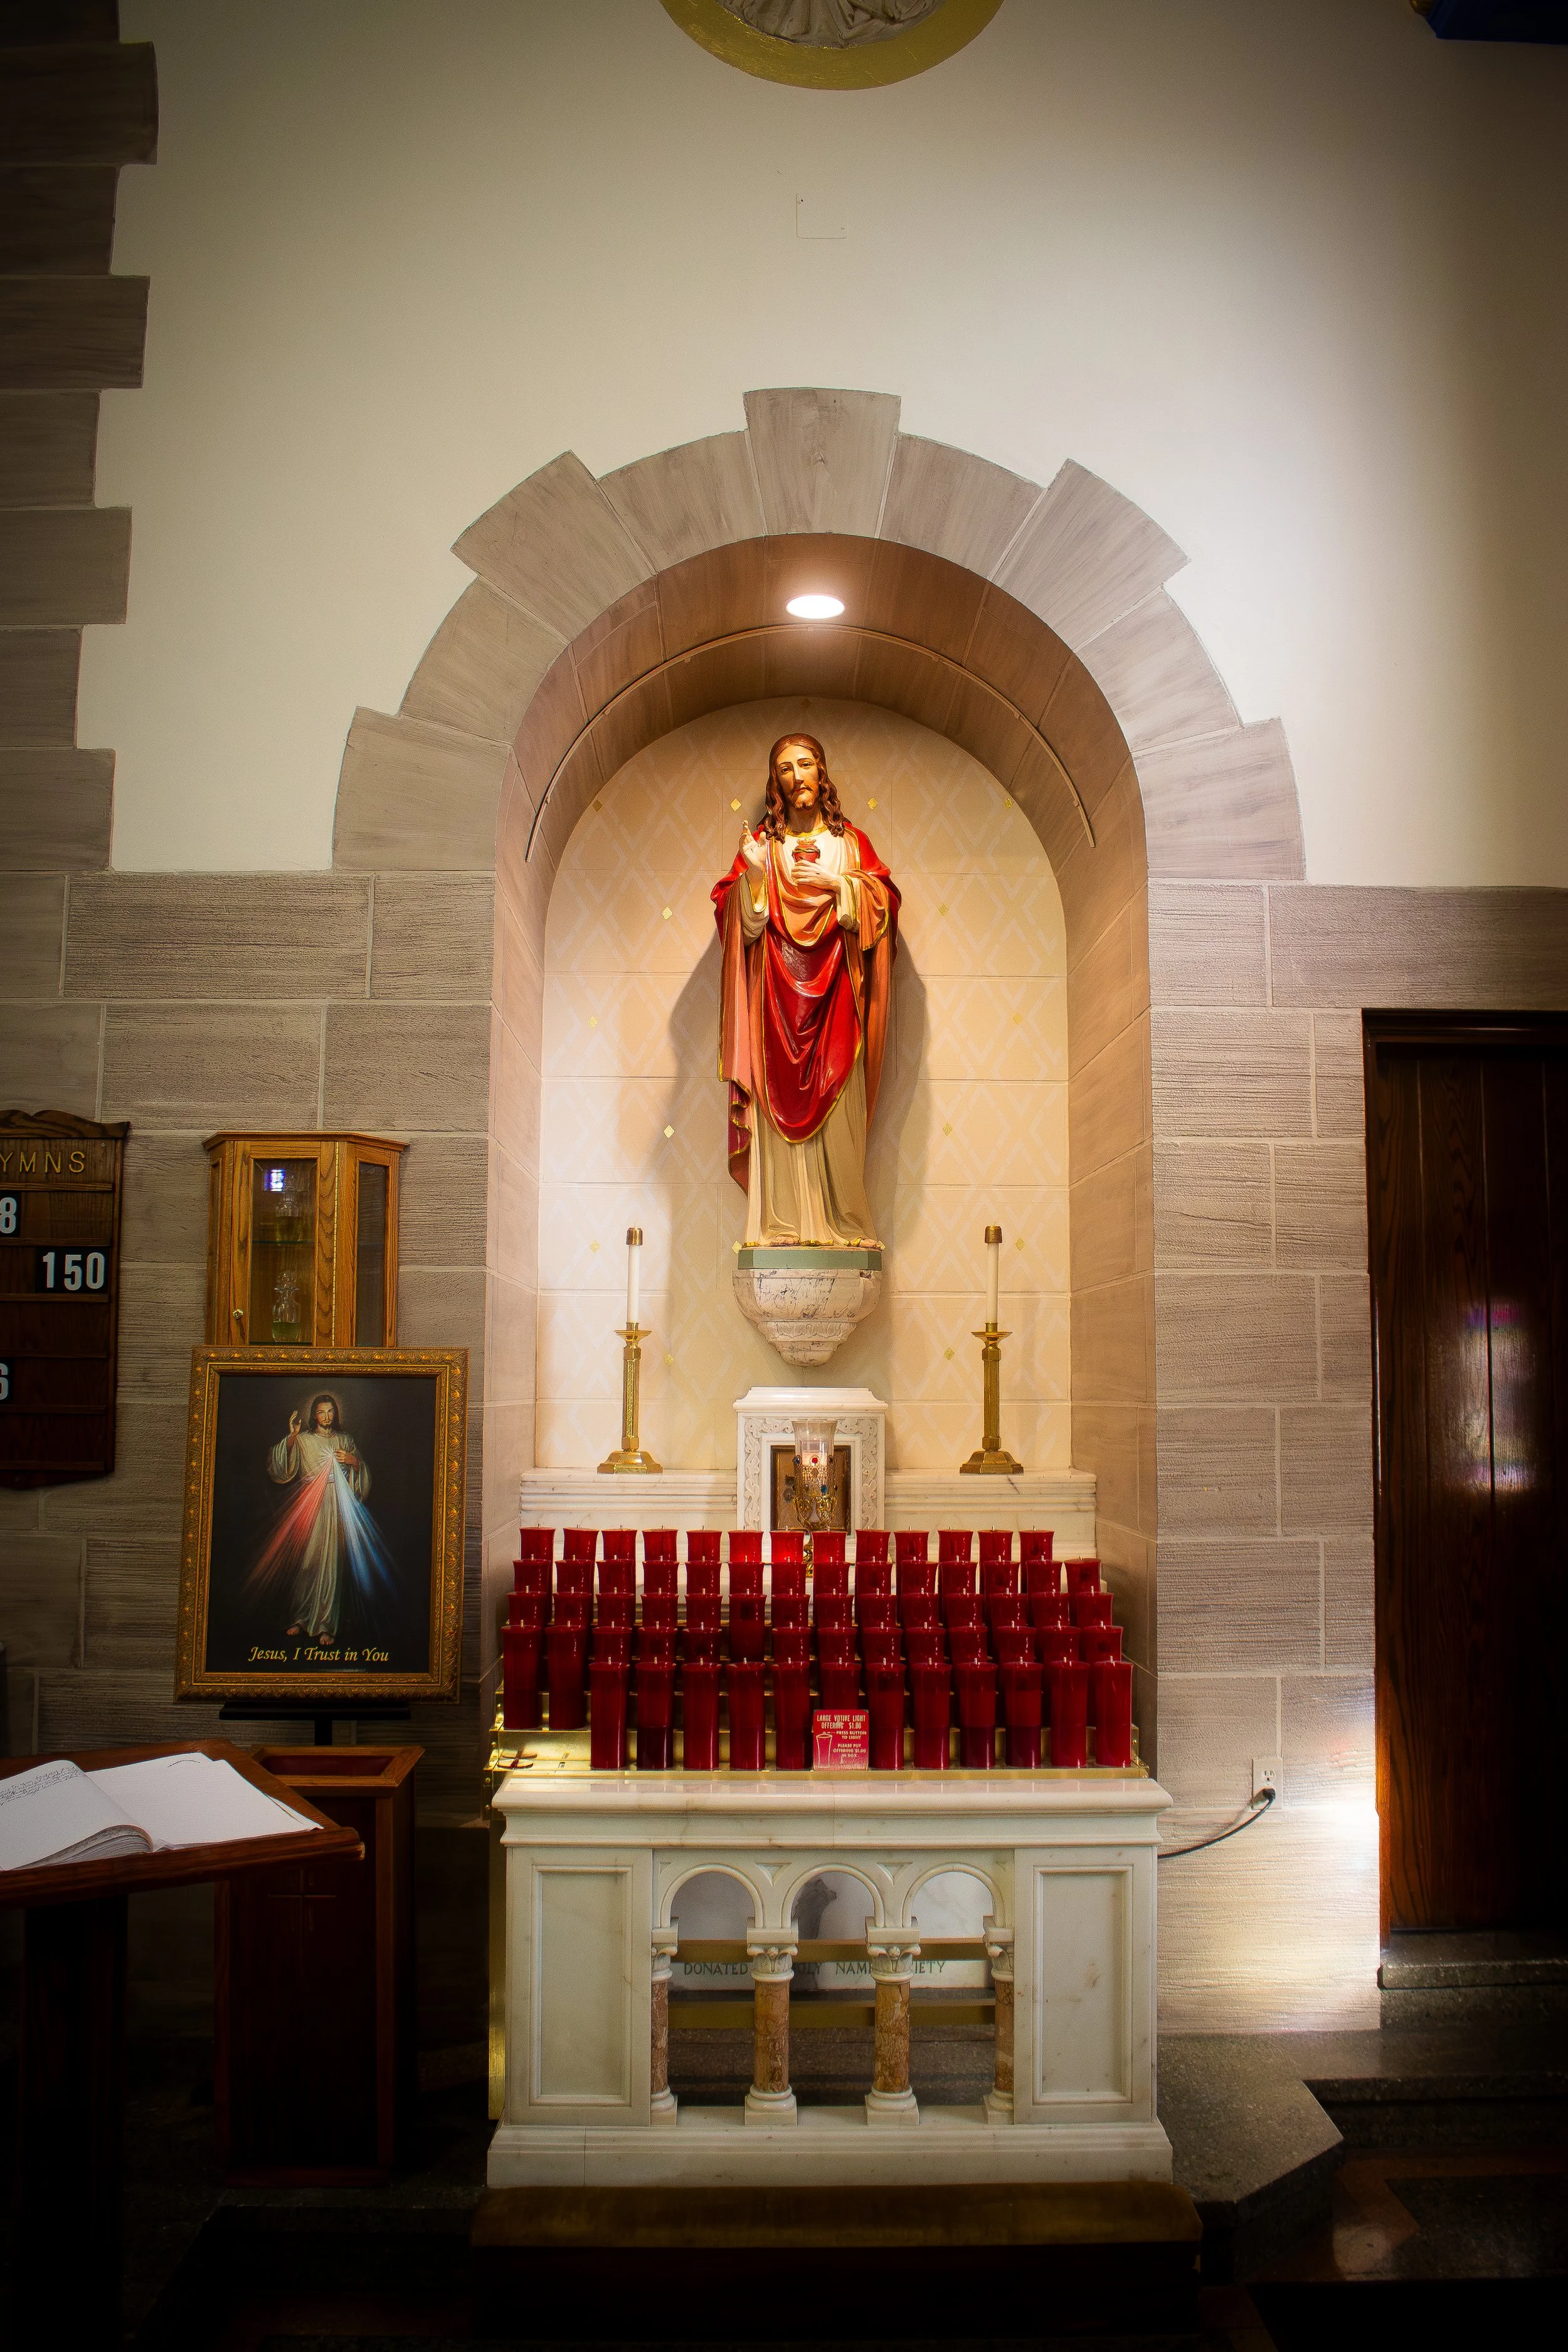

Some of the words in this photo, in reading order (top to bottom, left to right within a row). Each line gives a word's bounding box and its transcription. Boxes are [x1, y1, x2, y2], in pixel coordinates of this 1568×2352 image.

[0, 1150, 86, 1174] YMNS
[42, 1251, 106, 1291] 150
[248, 1646, 288, 1662] Jesus,
[293, 1647, 302, 1661] I
[304, 1646, 341, 1661] Trust
[344, 1647, 359, 1661] in
[362, 1646, 390, 1661] You
[684, 1963, 748, 1975] DONATED
[797, 1962, 823, 1974] OLY
[915, 1961, 945, 1974] IETY
